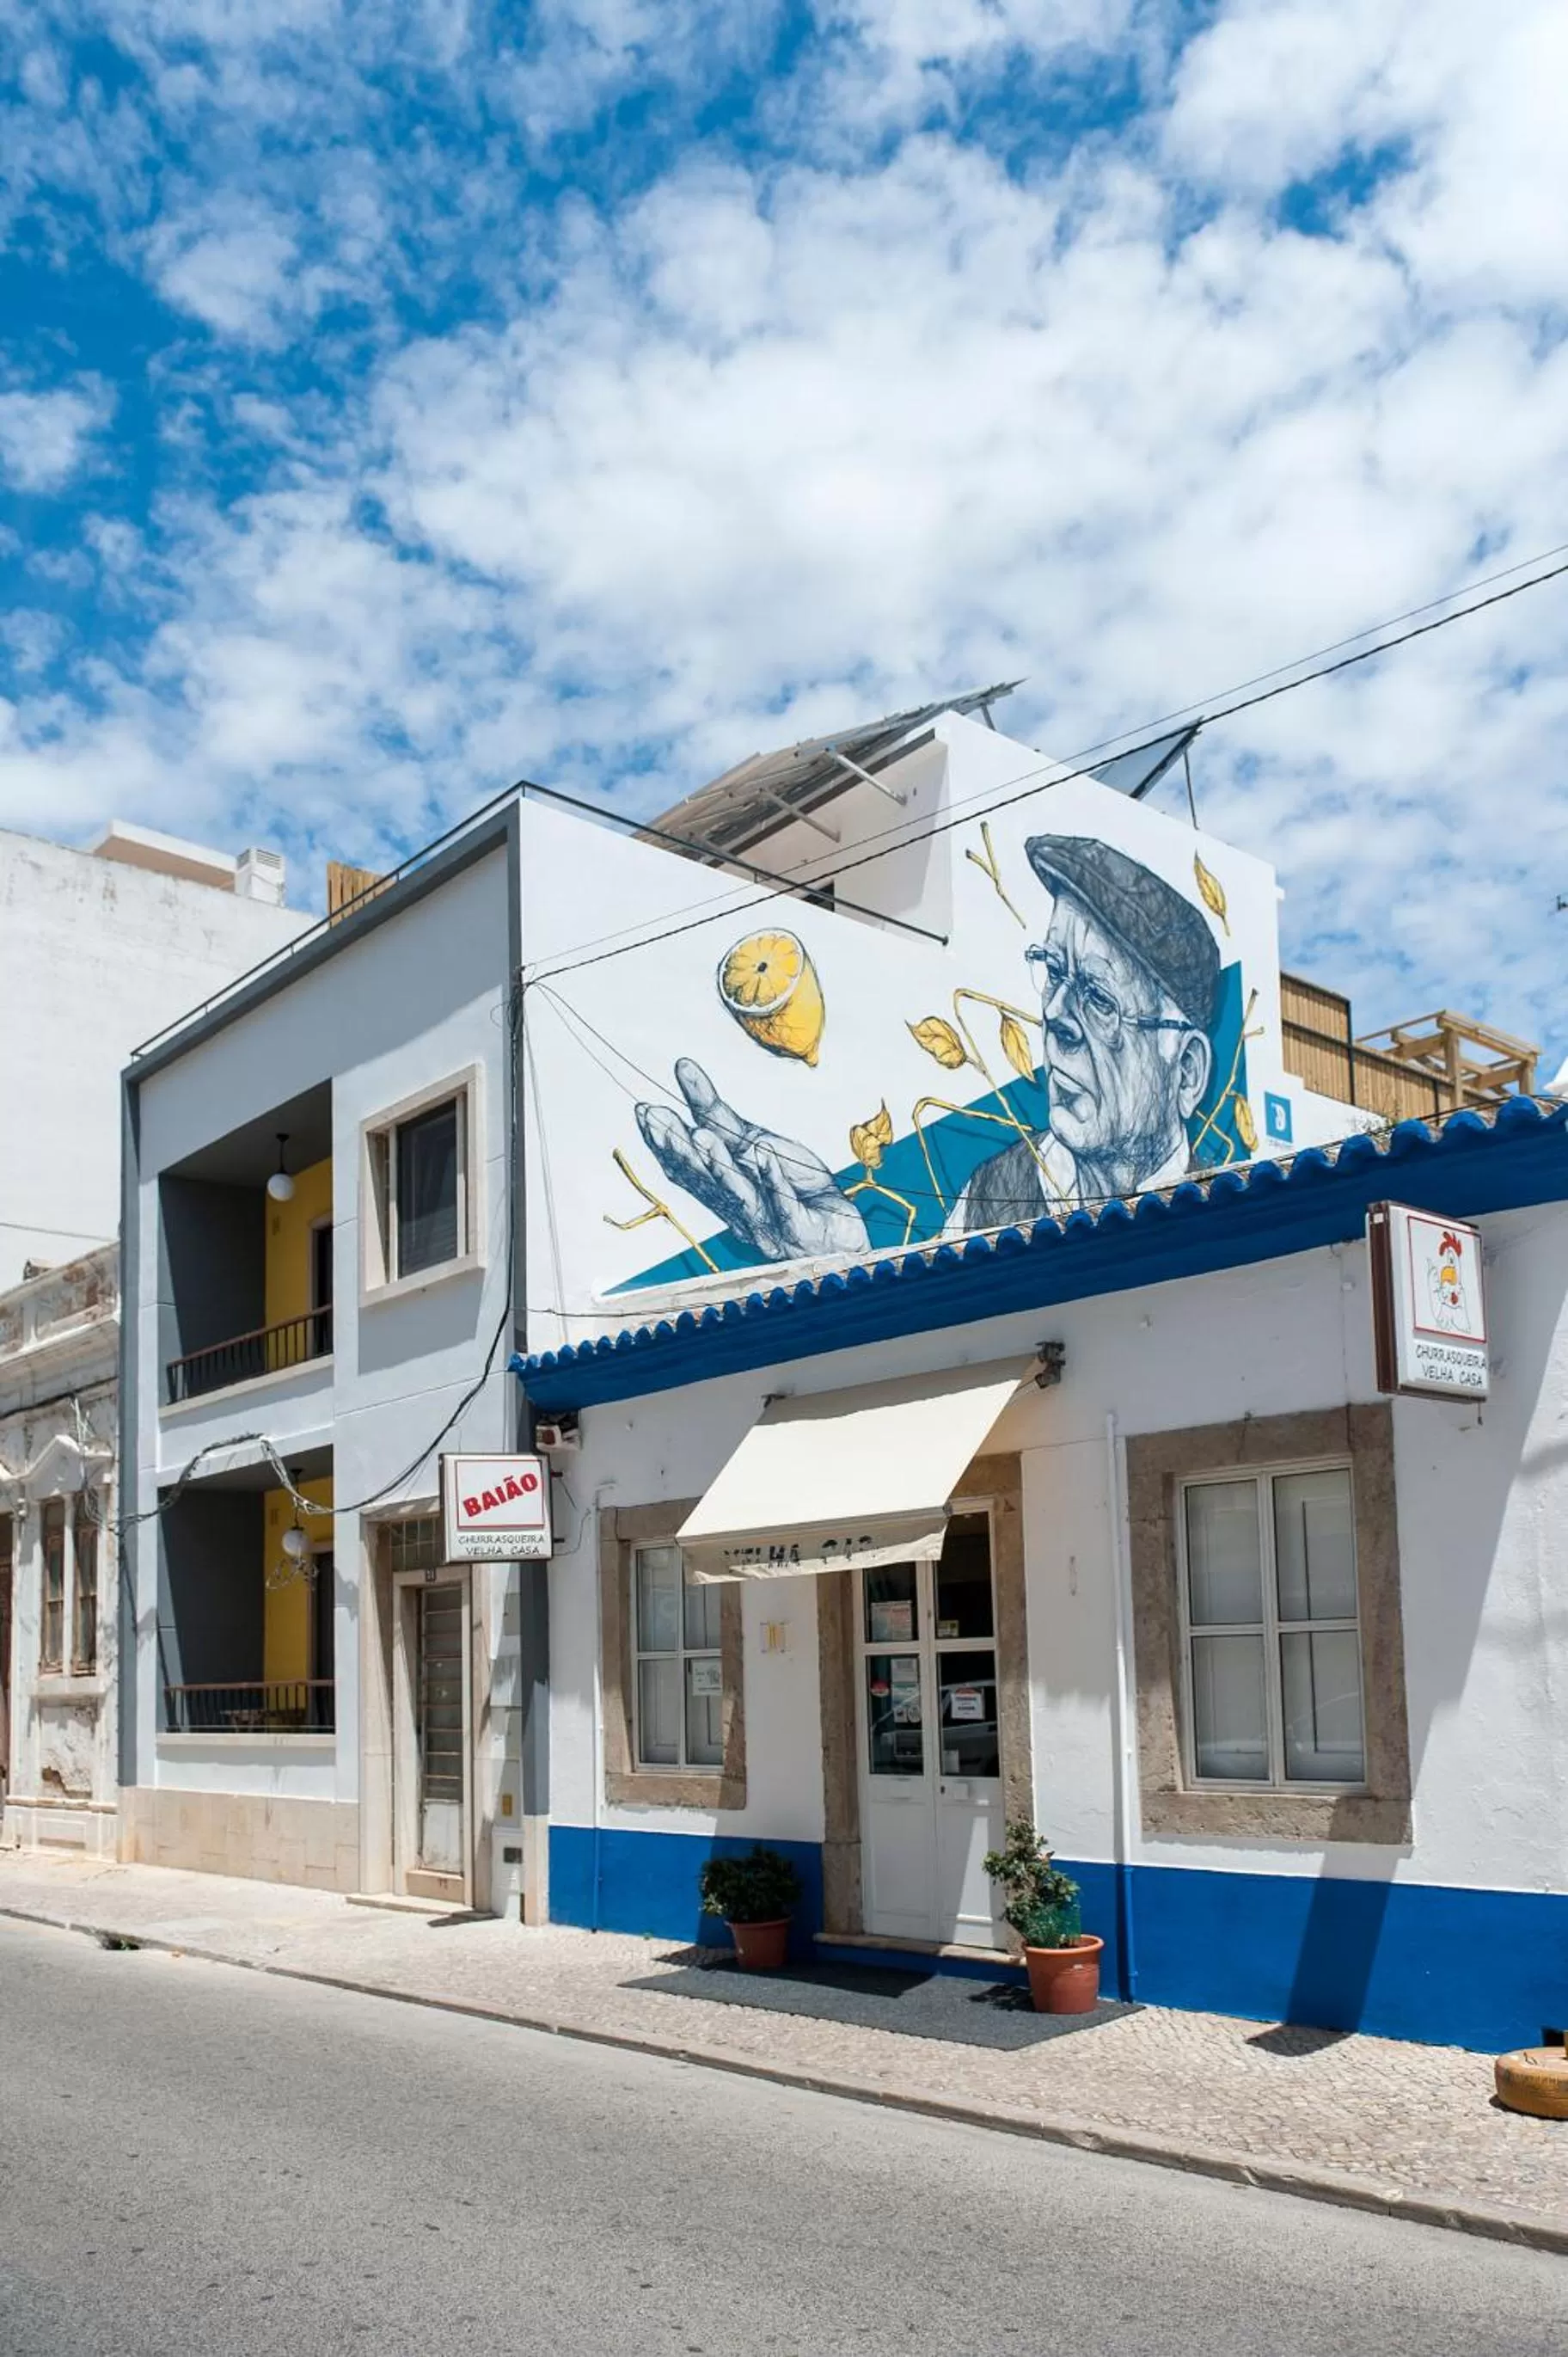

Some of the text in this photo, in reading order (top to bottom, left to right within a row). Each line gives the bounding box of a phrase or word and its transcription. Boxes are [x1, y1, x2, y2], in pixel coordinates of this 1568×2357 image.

[1417, 1344, 1487, 1371] CHURRASQUEIRA
[1423, 1363, 1483, 1387] VELHA CASA
[462, 1472, 538, 1518] BAIÃO
[458, 1534, 545, 1545] CHURRASQUEIRA
[466, 1546, 540, 1556] VELHA CASA
